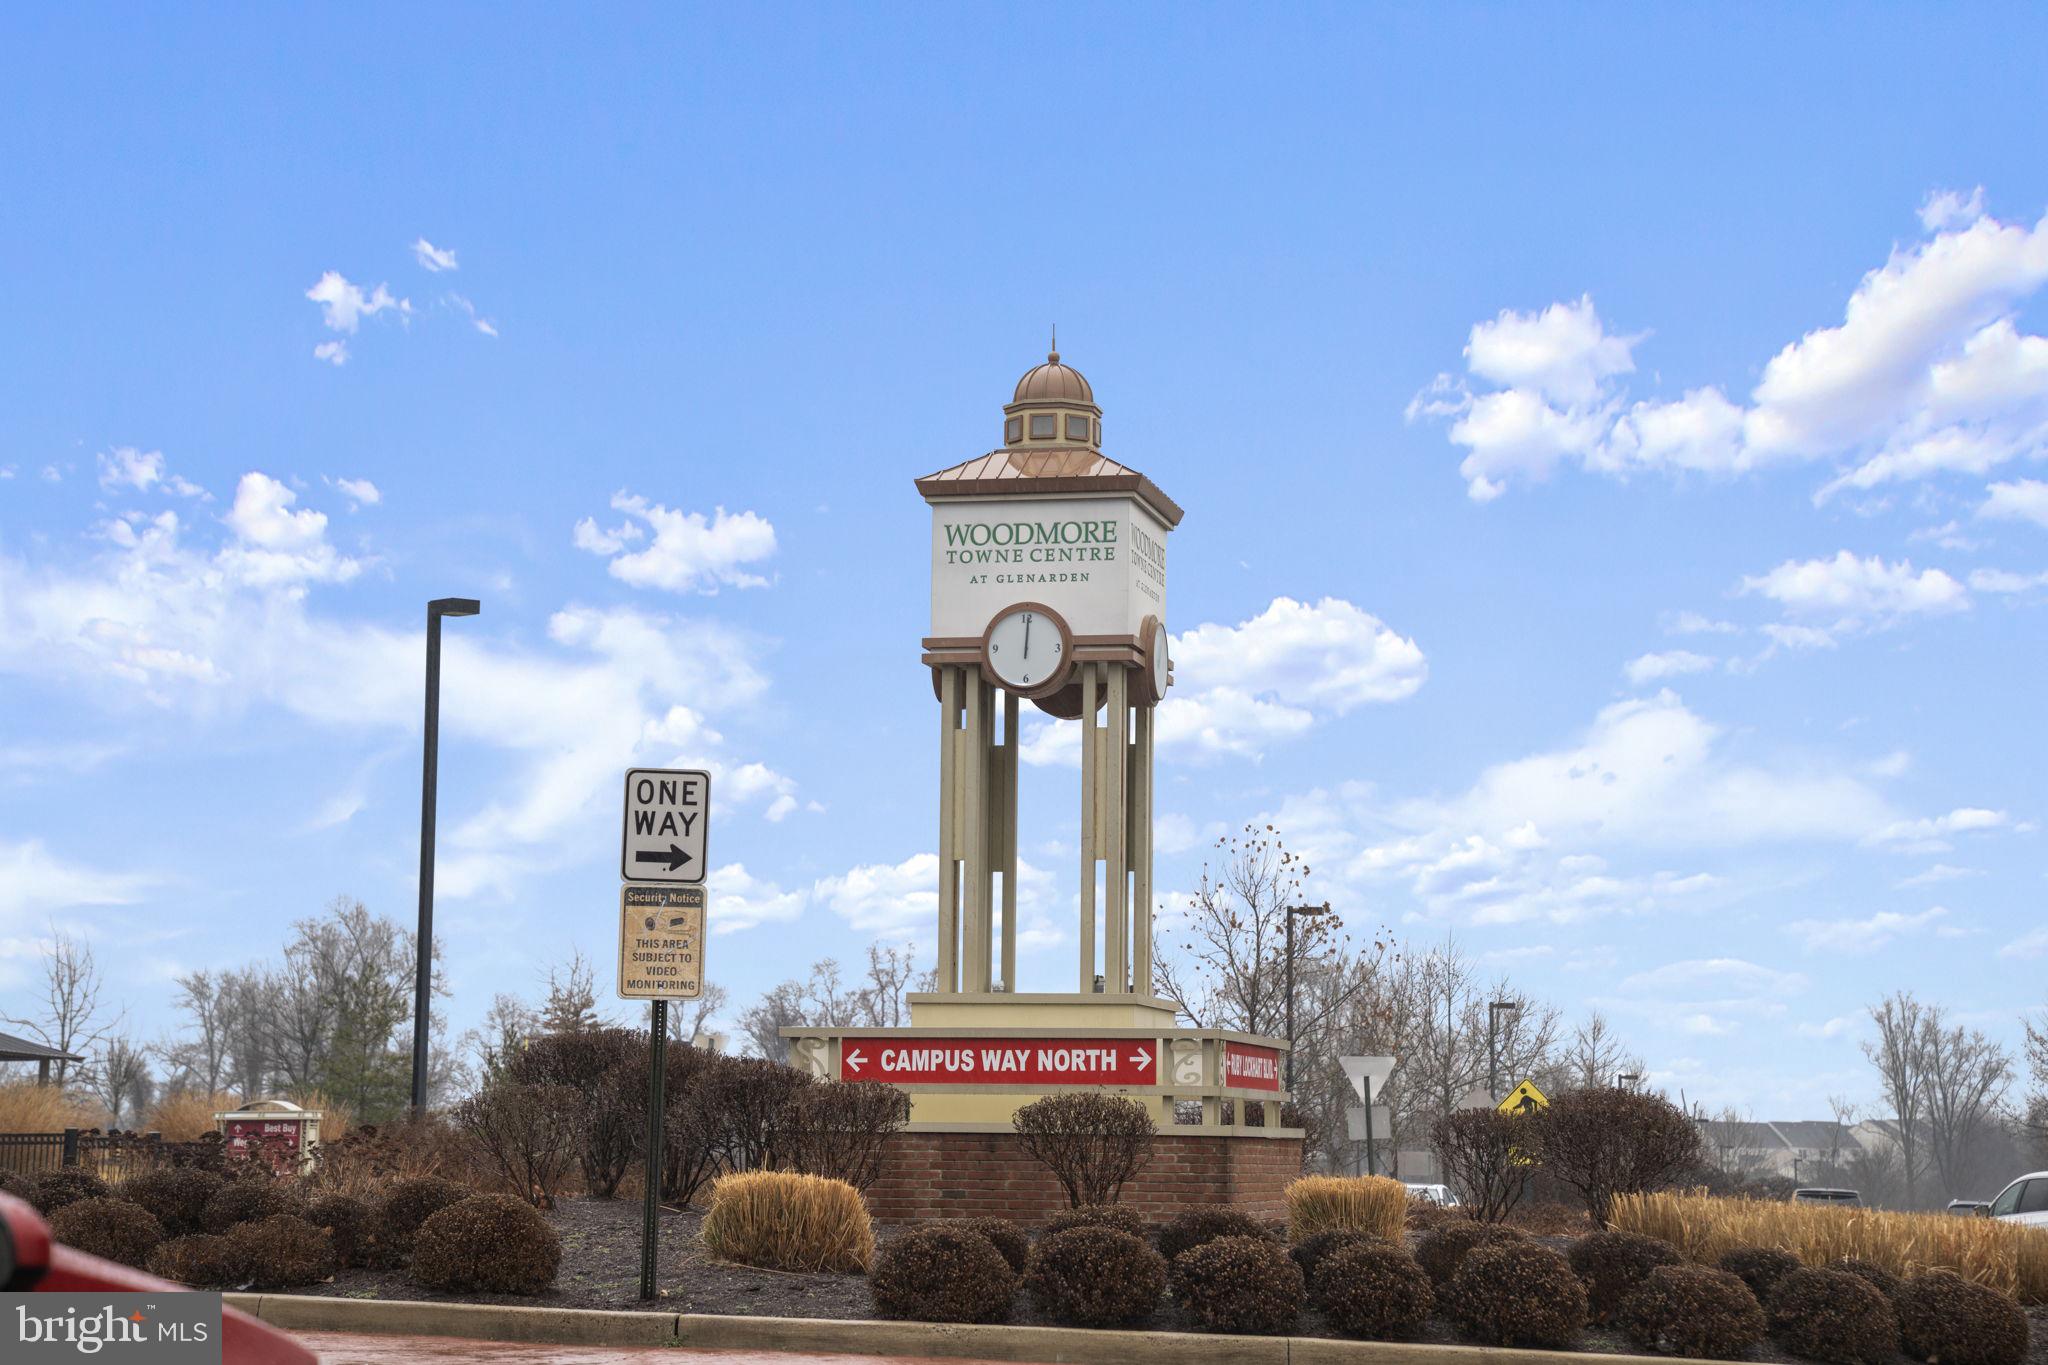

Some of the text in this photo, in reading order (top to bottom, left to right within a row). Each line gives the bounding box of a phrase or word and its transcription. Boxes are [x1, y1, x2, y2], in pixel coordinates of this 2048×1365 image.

[944, 520, 1118, 547] WOODMORE
[946, 546, 1115, 564] TOWNE CENTRE
[969, 572, 1091, 584] AT GLENARDEN
[1021, 614, 1033, 624] 12
[992, 644, 999, 654] 9
[1054, 643, 1061, 653] 3
[1023, 673, 1029, 683] 6
[636, 779, 698, 806] ONE
[634, 810, 698, 837] WAY
[669, 893, 701, 904] Notice
[636, 939, 689, 950] THIS AREA
[632, 953, 692, 963] SUBJECT TO
[646, 966, 677, 977] VIDEO
[627, 979, 695, 991] MONITORING
[880, 1048, 1117, 1073] CAMPUS WAY NORTH
[264, 1123, 297, 1135] Best Buy
